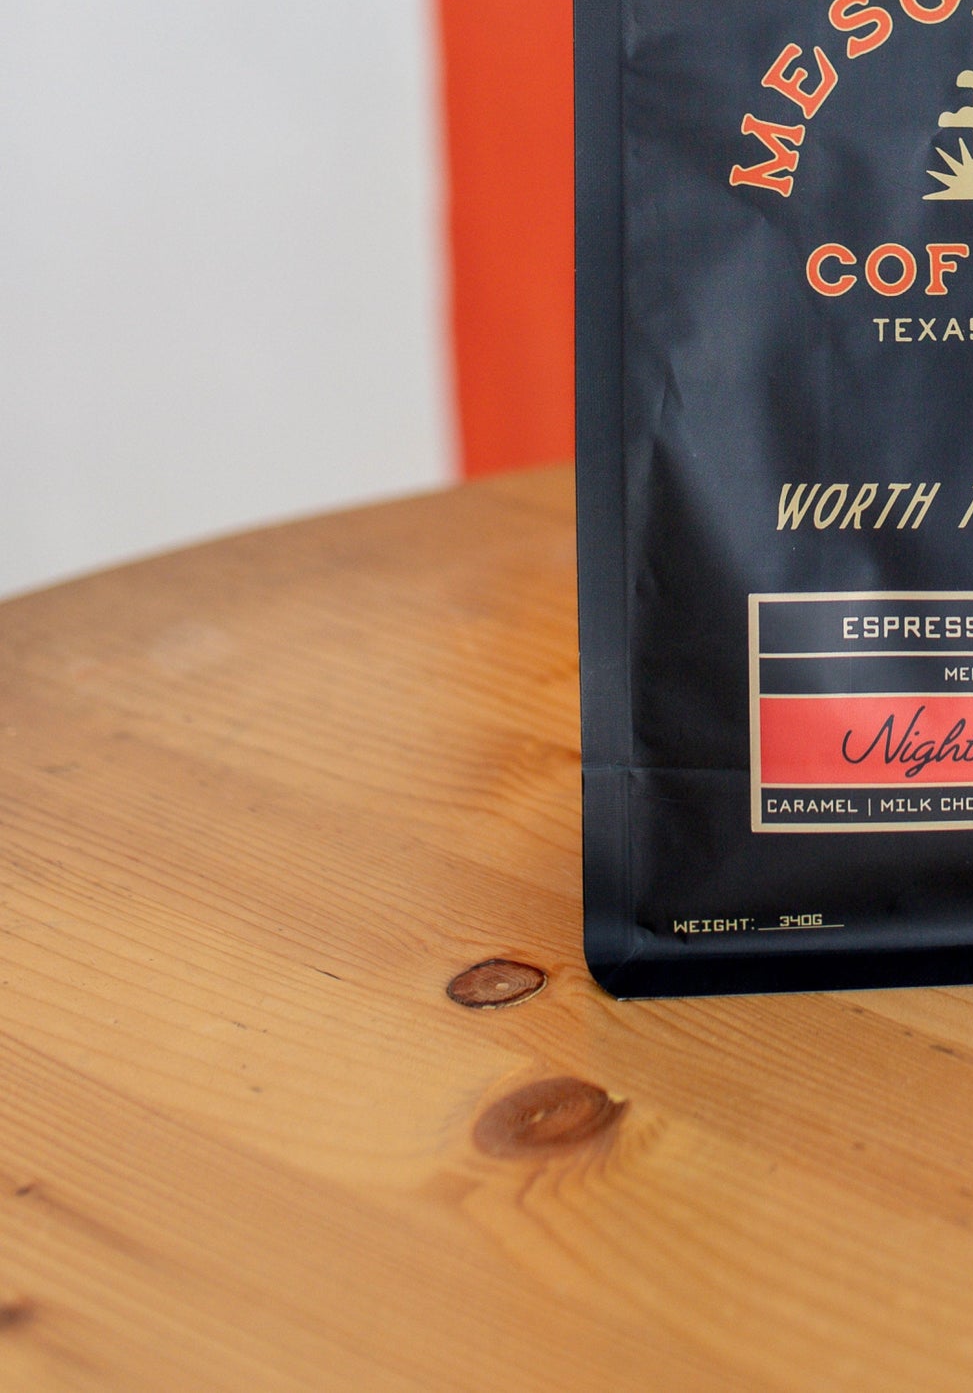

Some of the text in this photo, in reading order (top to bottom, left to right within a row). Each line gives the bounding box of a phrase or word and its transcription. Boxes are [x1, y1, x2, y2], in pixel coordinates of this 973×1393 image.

[776, 482, 941, 530] WORTH
[767, 797, 859, 814] CARAMEL
[880, 797, 932, 812] MILK
[673, 913, 823, 934] WEIGHT: 340G
